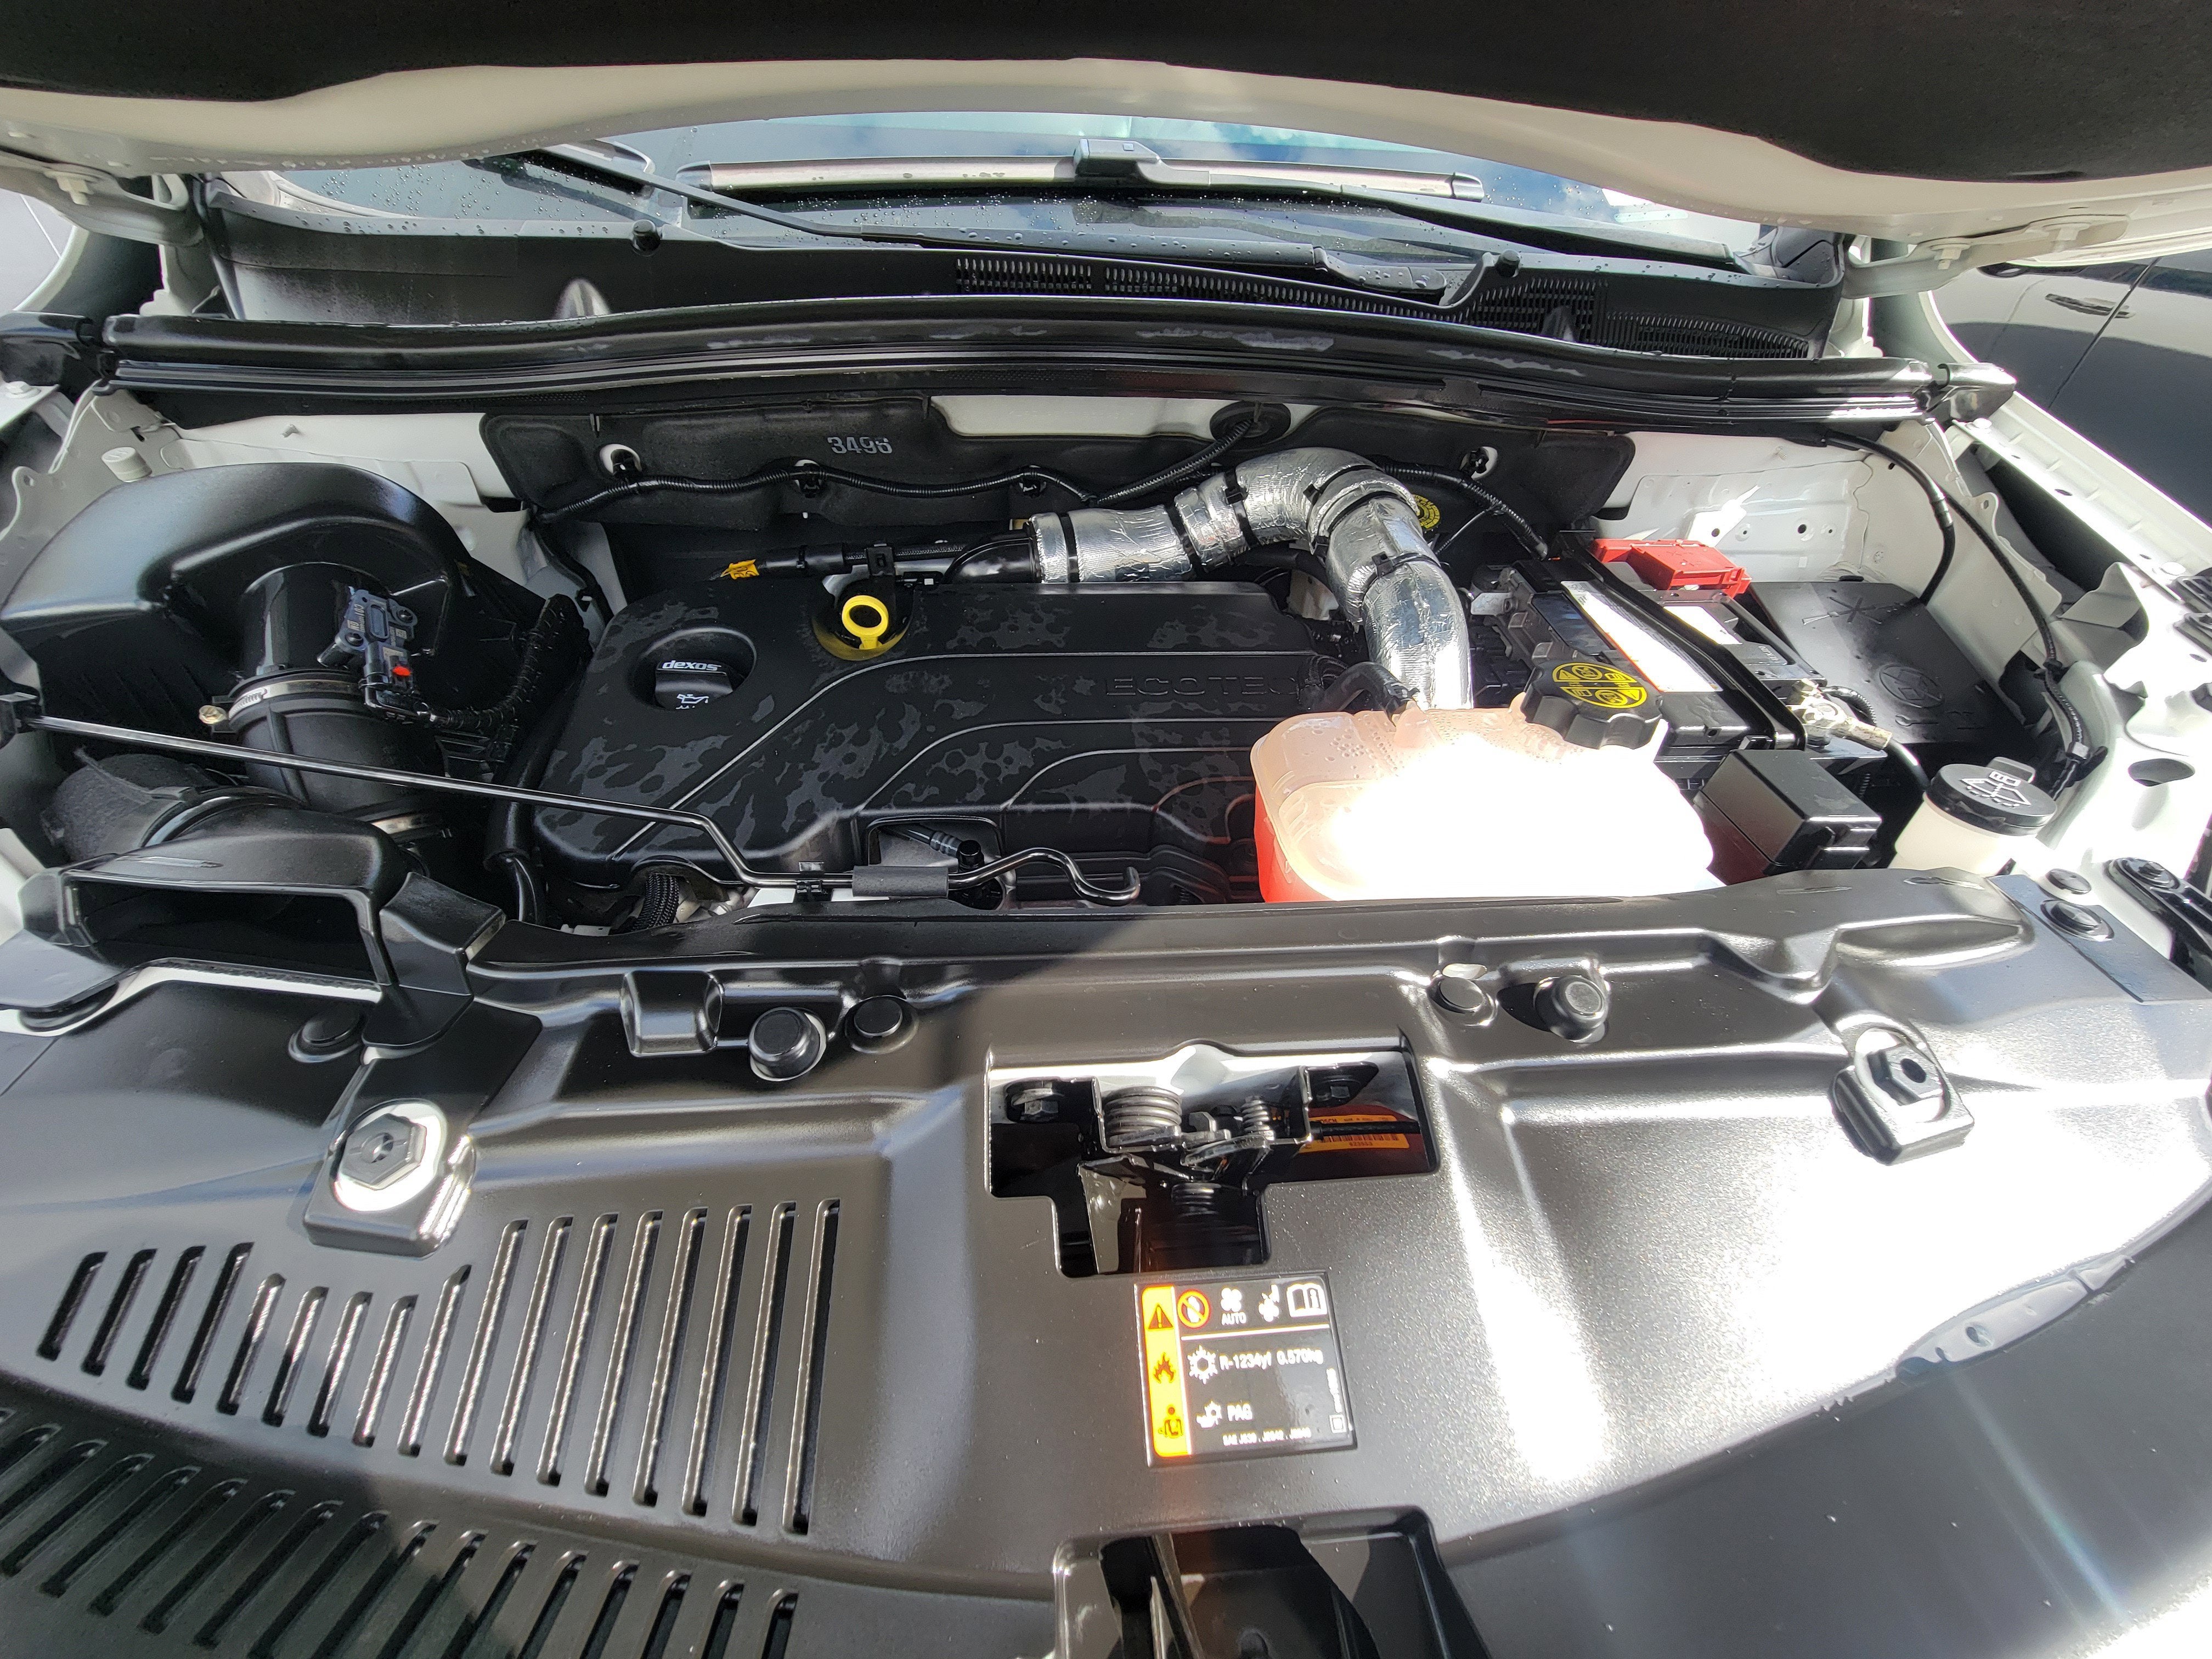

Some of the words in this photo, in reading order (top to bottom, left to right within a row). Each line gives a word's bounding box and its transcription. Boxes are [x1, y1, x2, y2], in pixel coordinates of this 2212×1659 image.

[827, 437, 893, 454] 3496
[662, 660, 721, 671] dexos
[1221, 1312, 1246, 1325] AUTO
[1219, 1351, 1272, 1370] R-1234yf
[1227, 1403, 1253, 1421] PAG
